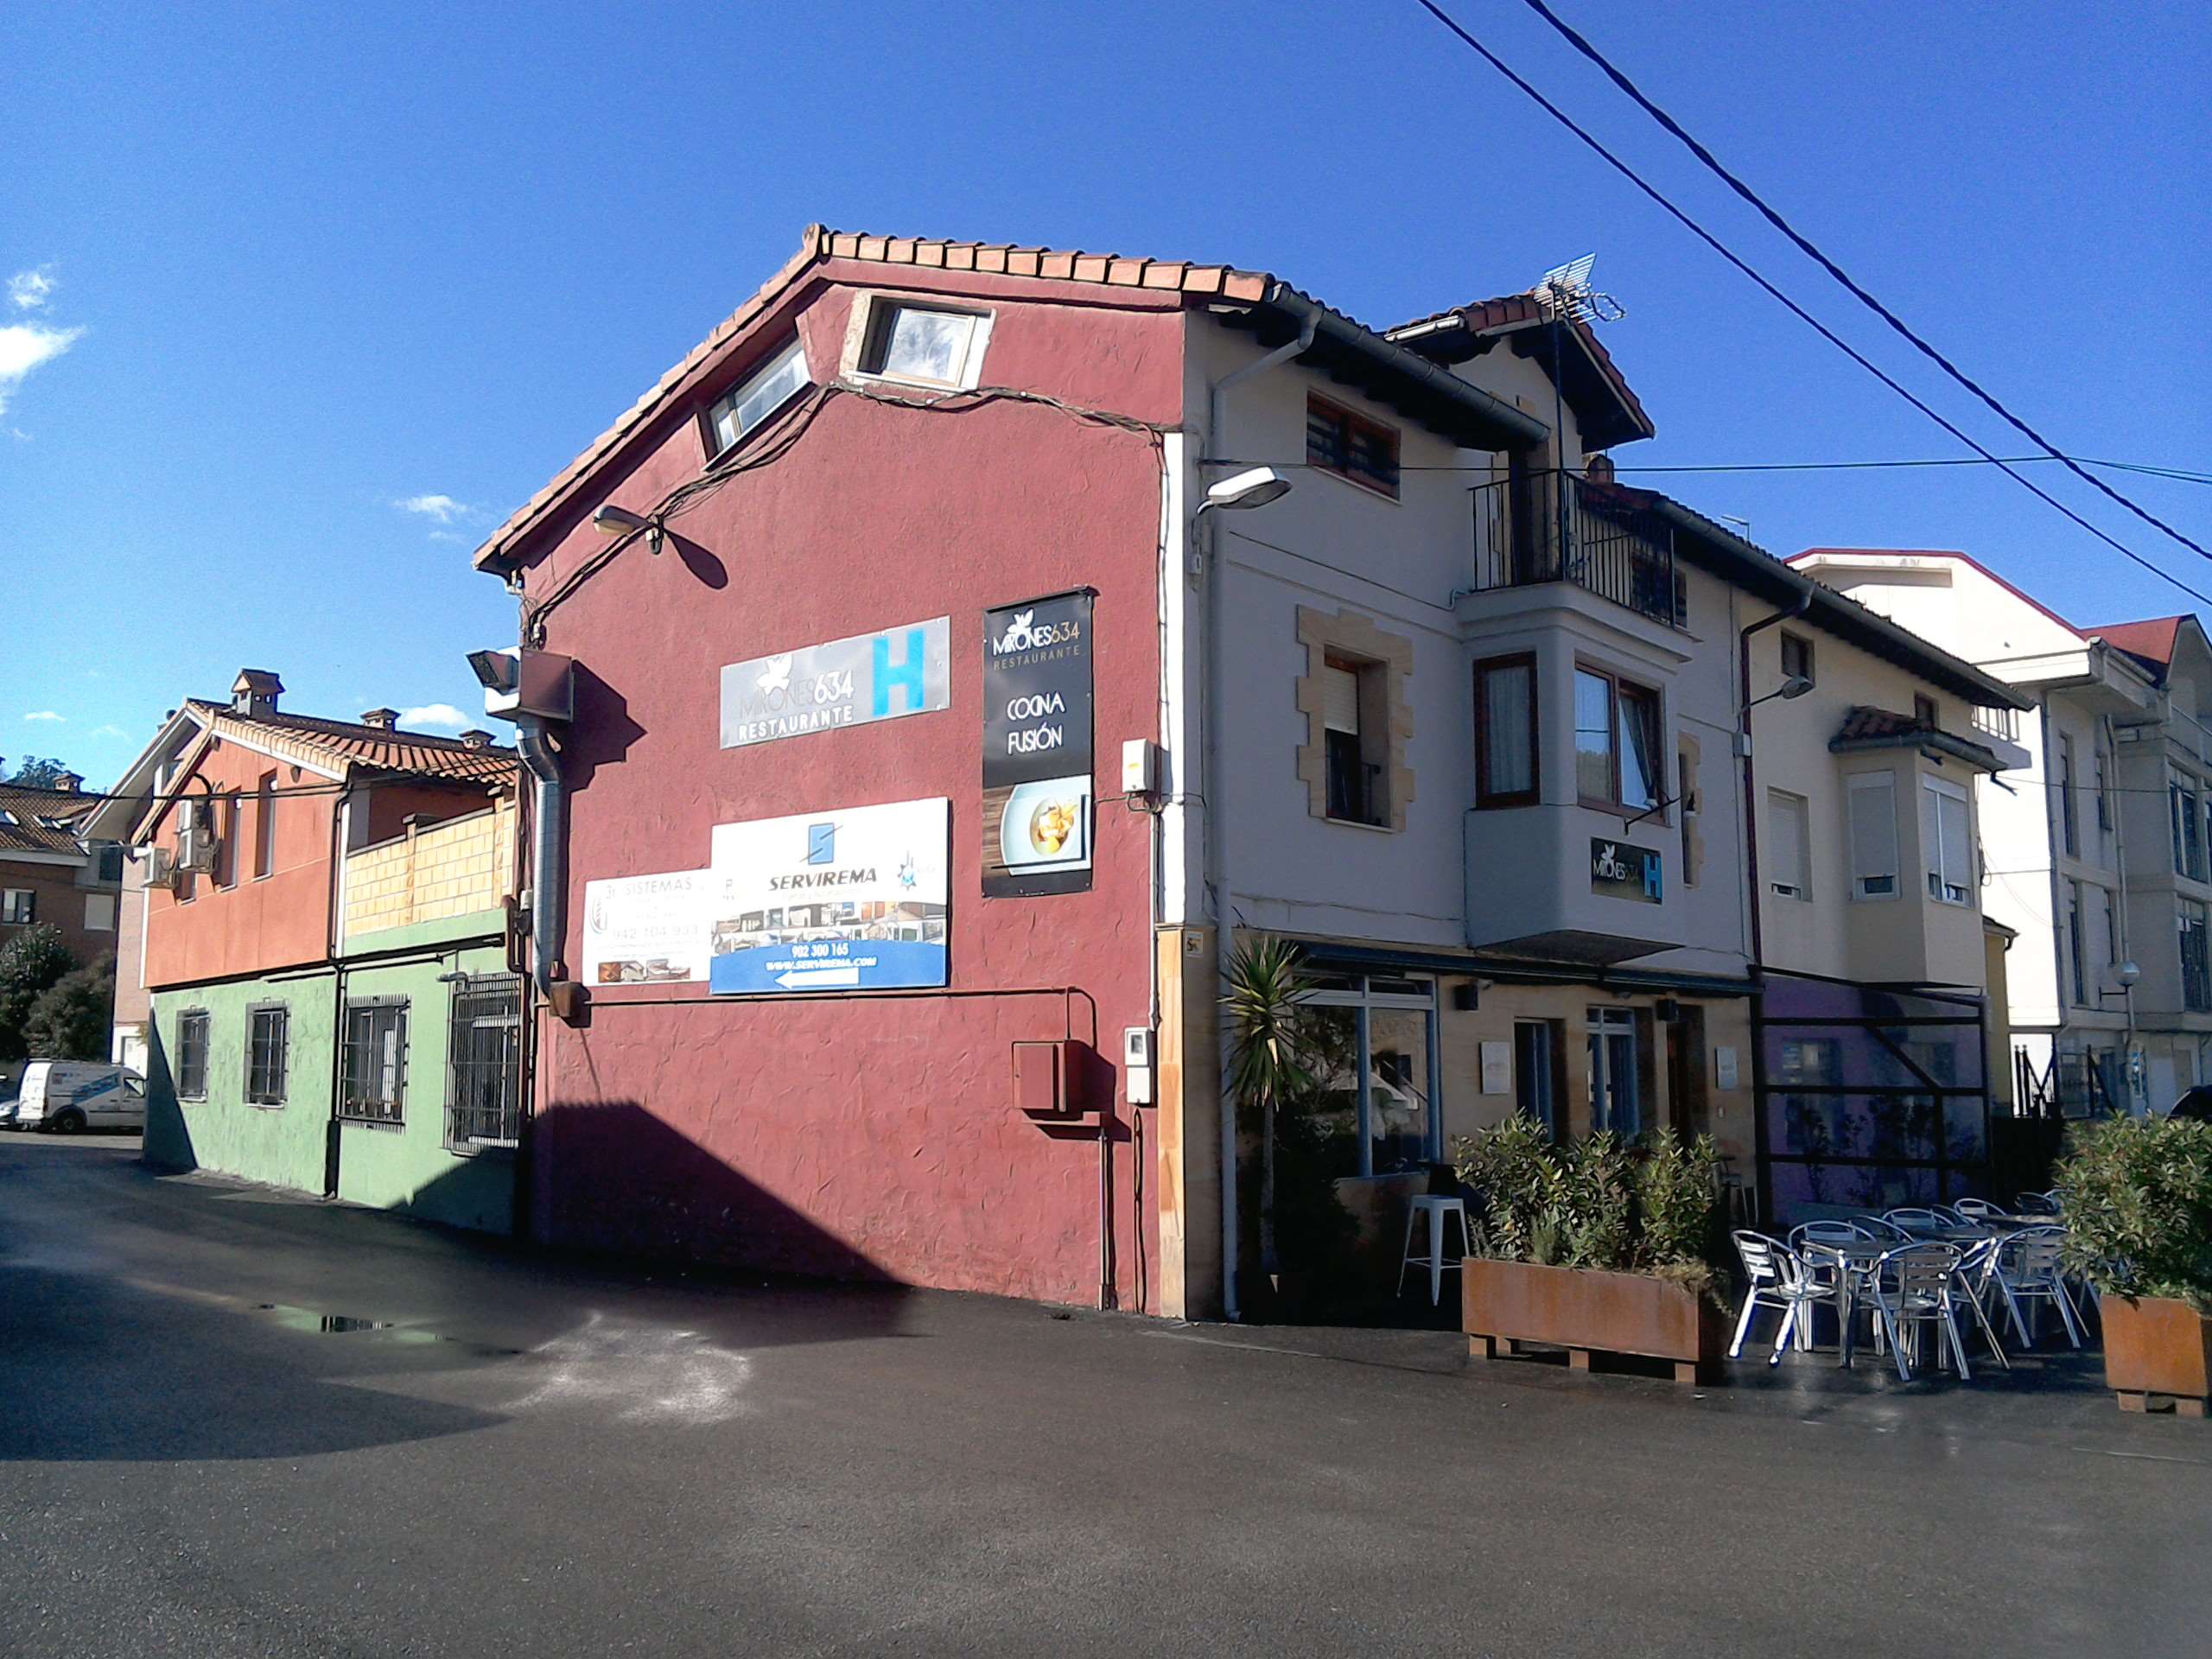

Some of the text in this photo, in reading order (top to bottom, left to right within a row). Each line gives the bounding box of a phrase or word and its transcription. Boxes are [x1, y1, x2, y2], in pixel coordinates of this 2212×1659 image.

[994, 645, 1079, 671] RESTAURANTE
[872, 629, 925, 717] H
[1007, 692, 1065, 721] COCINA
[738, 704, 854, 741] RESTAURANTE
[1007, 721, 1063, 755] FUSIÓN
[624, 876, 693, 896] SISTEMAS
[767, 868, 878, 892] SERVIREMA
[1644, 854, 1662, 899] H
[791, 943, 849, 958] 902 300 165
[765, 957, 878, 972] WWW.SERVIREMA.COM
